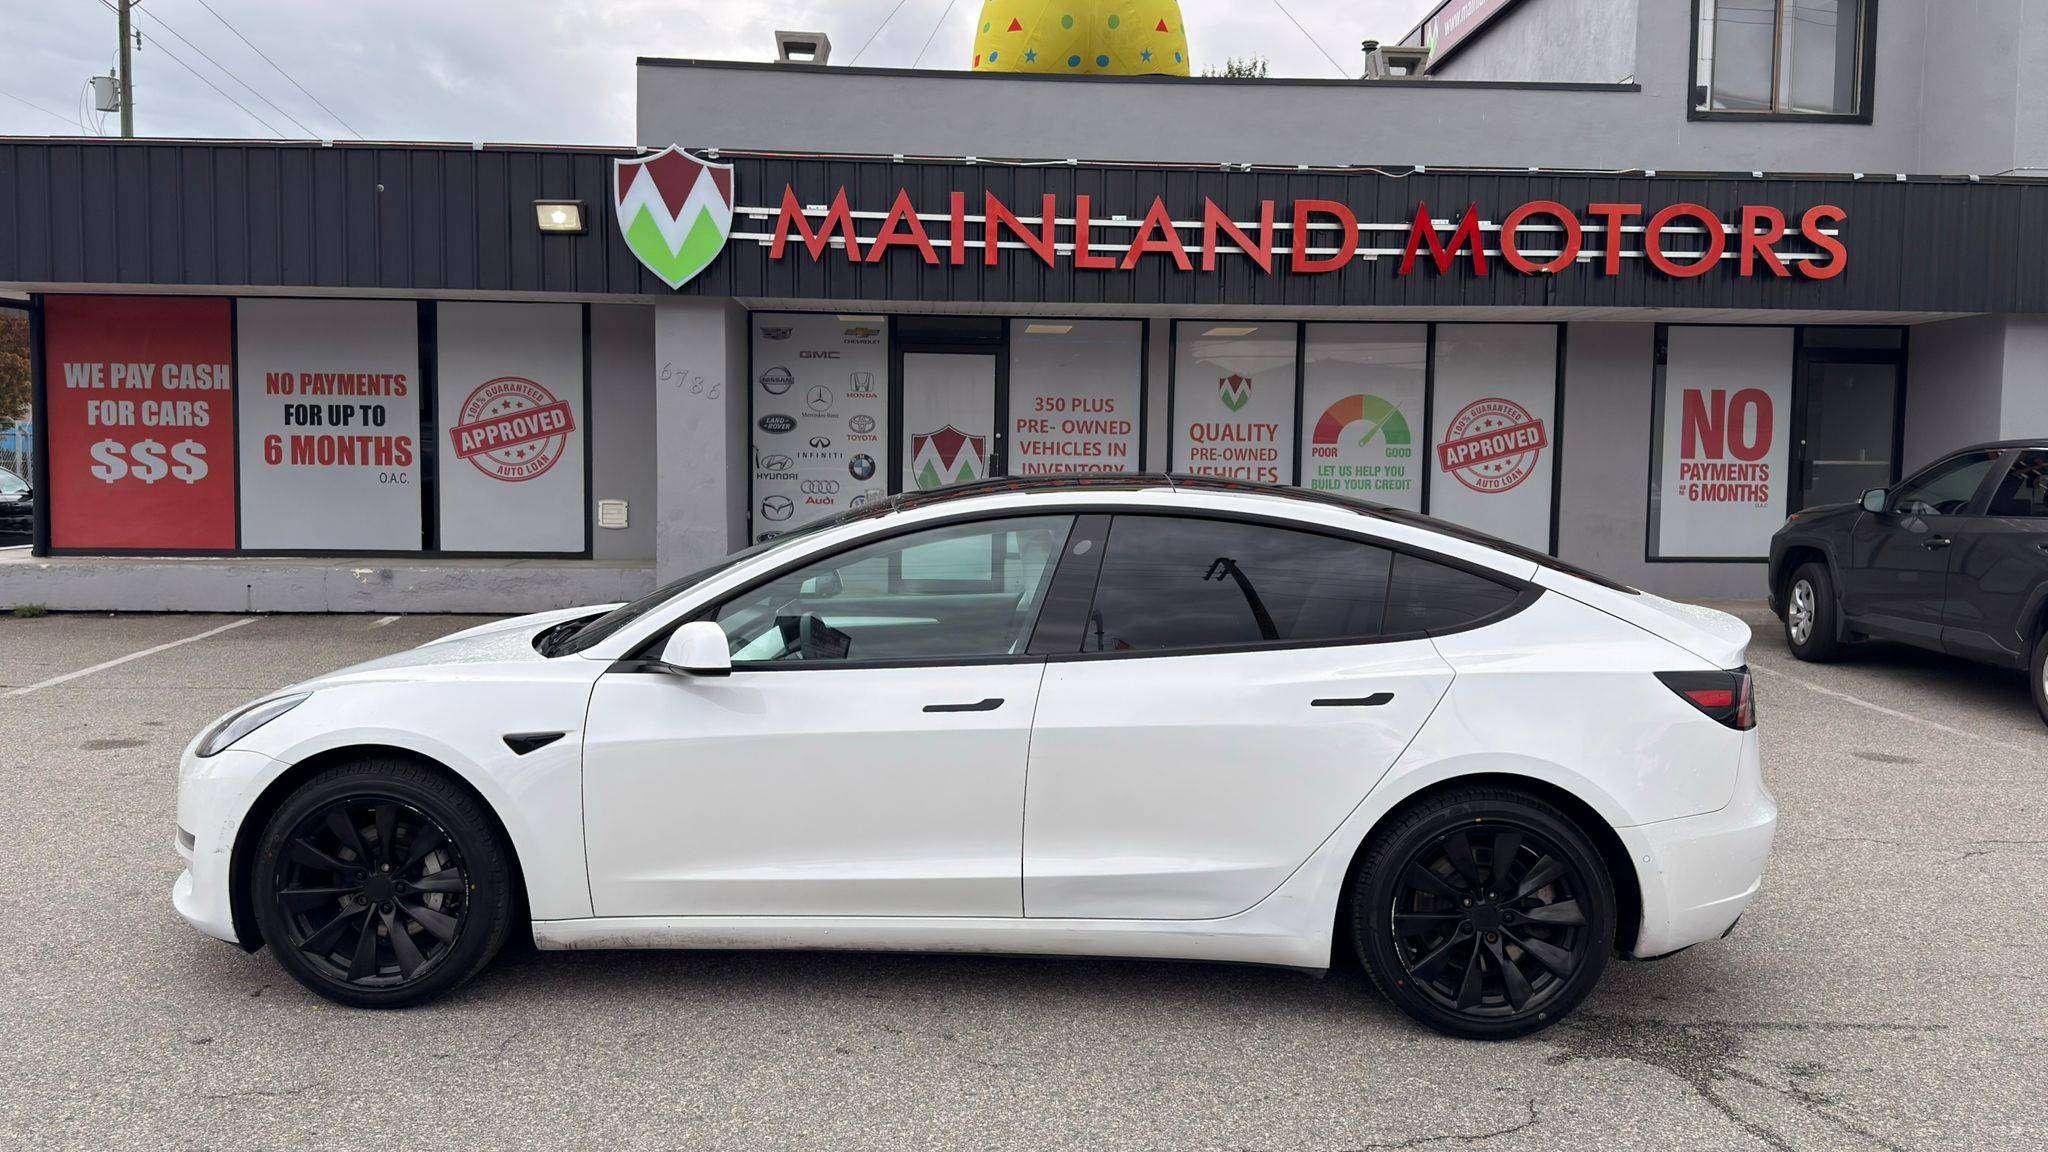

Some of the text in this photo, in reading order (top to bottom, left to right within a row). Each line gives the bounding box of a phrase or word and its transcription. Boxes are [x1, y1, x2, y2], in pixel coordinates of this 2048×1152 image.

[768, 183, 1848, 280] MAINLAND MOTORS
[800, 351, 840, 359] GMC
[63, 363, 230, 390] WE PAY CASH
[266, 372, 407, 397] NO PAYMENTS
[660, 360, 721, 400] 6786
[468, 383, 544, 418] 100% GUARANTEED
[1034, 397, 1115, 413] 350 PLUS
[87, 400, 210, 427] FOR CARS
[284, 404, 386, 427] FOR UP TO
[1470, 404, 1522, 421] GUARANTEED
[461, 409, 567, 453] APPROVED
[1016, 418, 1132, 435] PRE- OWNED
[1189, 423, 1279, 443] QUALITY
[1681, 388, 1774, 462] NO
[263, 434, 413, 467] 6 MONTHS
[1019, 441, 1127, 457] VEHICLES IN
[1190, 447, 1278, 461] PRE-OWNED
[1312, 447, 1412, 458] POOR GOOD
[1446, 426, 1540, 466] APPROVED
[90, 438, 209, 485] $$$
[497, 454, 551, 477] AUTO LOAN
[1317, 465, 1405, 477] LET US HELP YOU
[379, 472, 410, 485] O.A.C.
[756, 472, 798, 480] HYUNDAI
[1475, 469, 1524, 489] AUTO LOAN
[1680, 463, 1770, 482] PAYMENTS
[1311, 479, 1412, 490] BUILD YOUR CREDIT
[1689, 483, 1699, 502] 6
[1701, 483, 1769, 503] MONTHS
[805, 496, 834, 505] Audi
